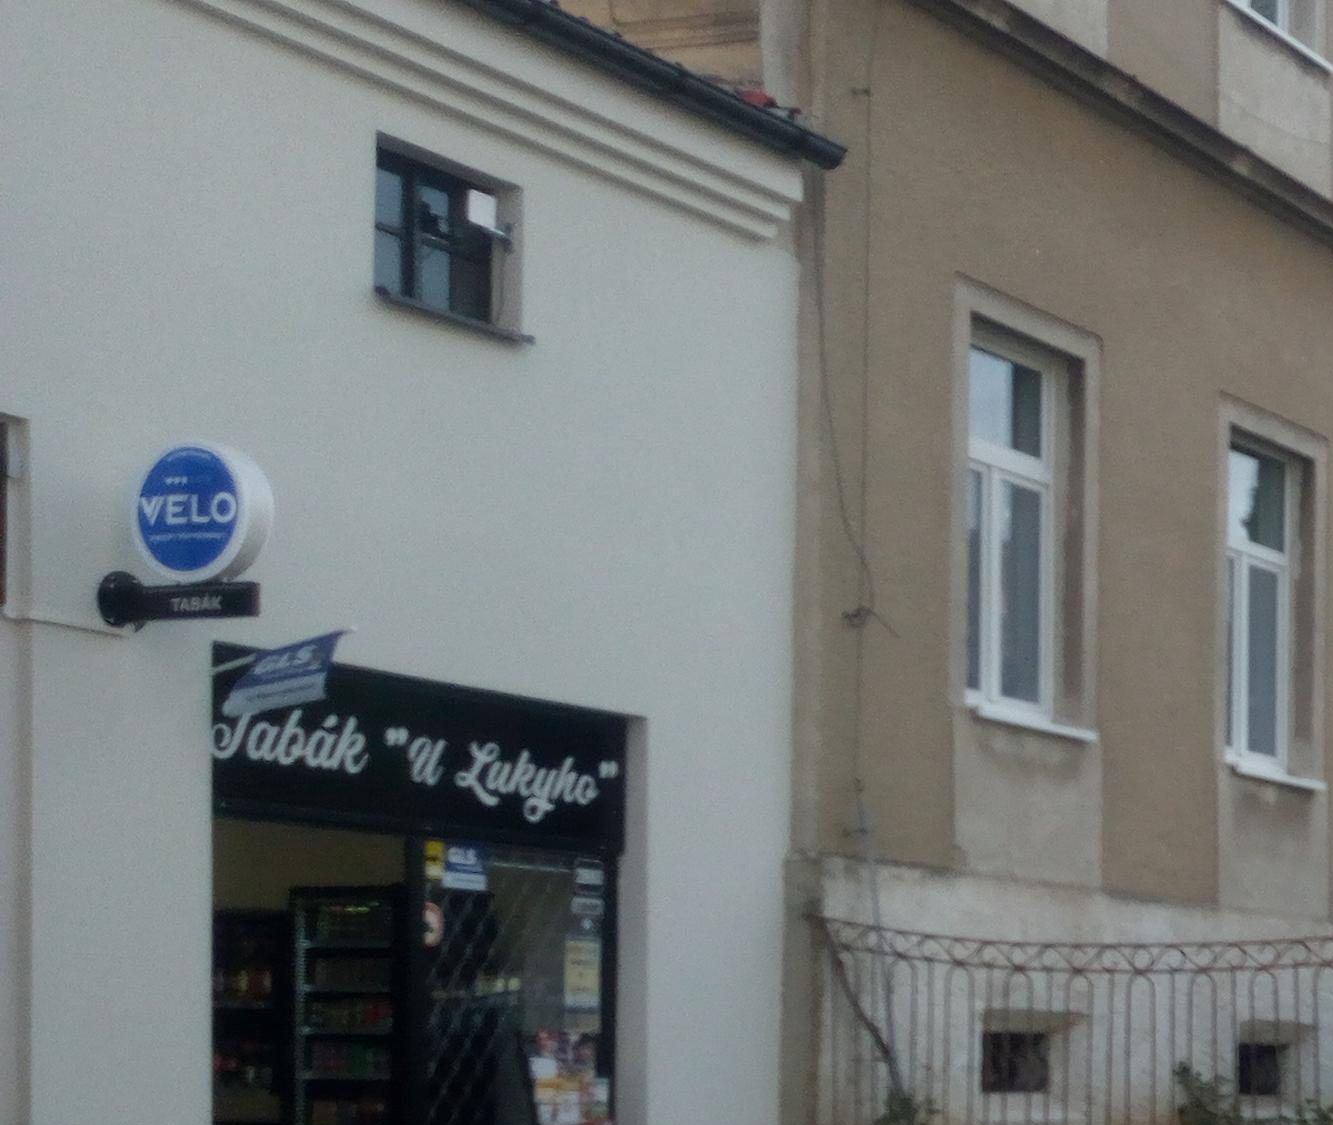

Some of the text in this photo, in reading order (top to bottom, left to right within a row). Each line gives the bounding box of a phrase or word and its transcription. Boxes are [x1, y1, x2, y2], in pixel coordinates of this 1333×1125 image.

[139, 491, 238, 526] VELO
[169, 592, 223, 613] TABÁK
[213, 708, 370, 775] Tabák
